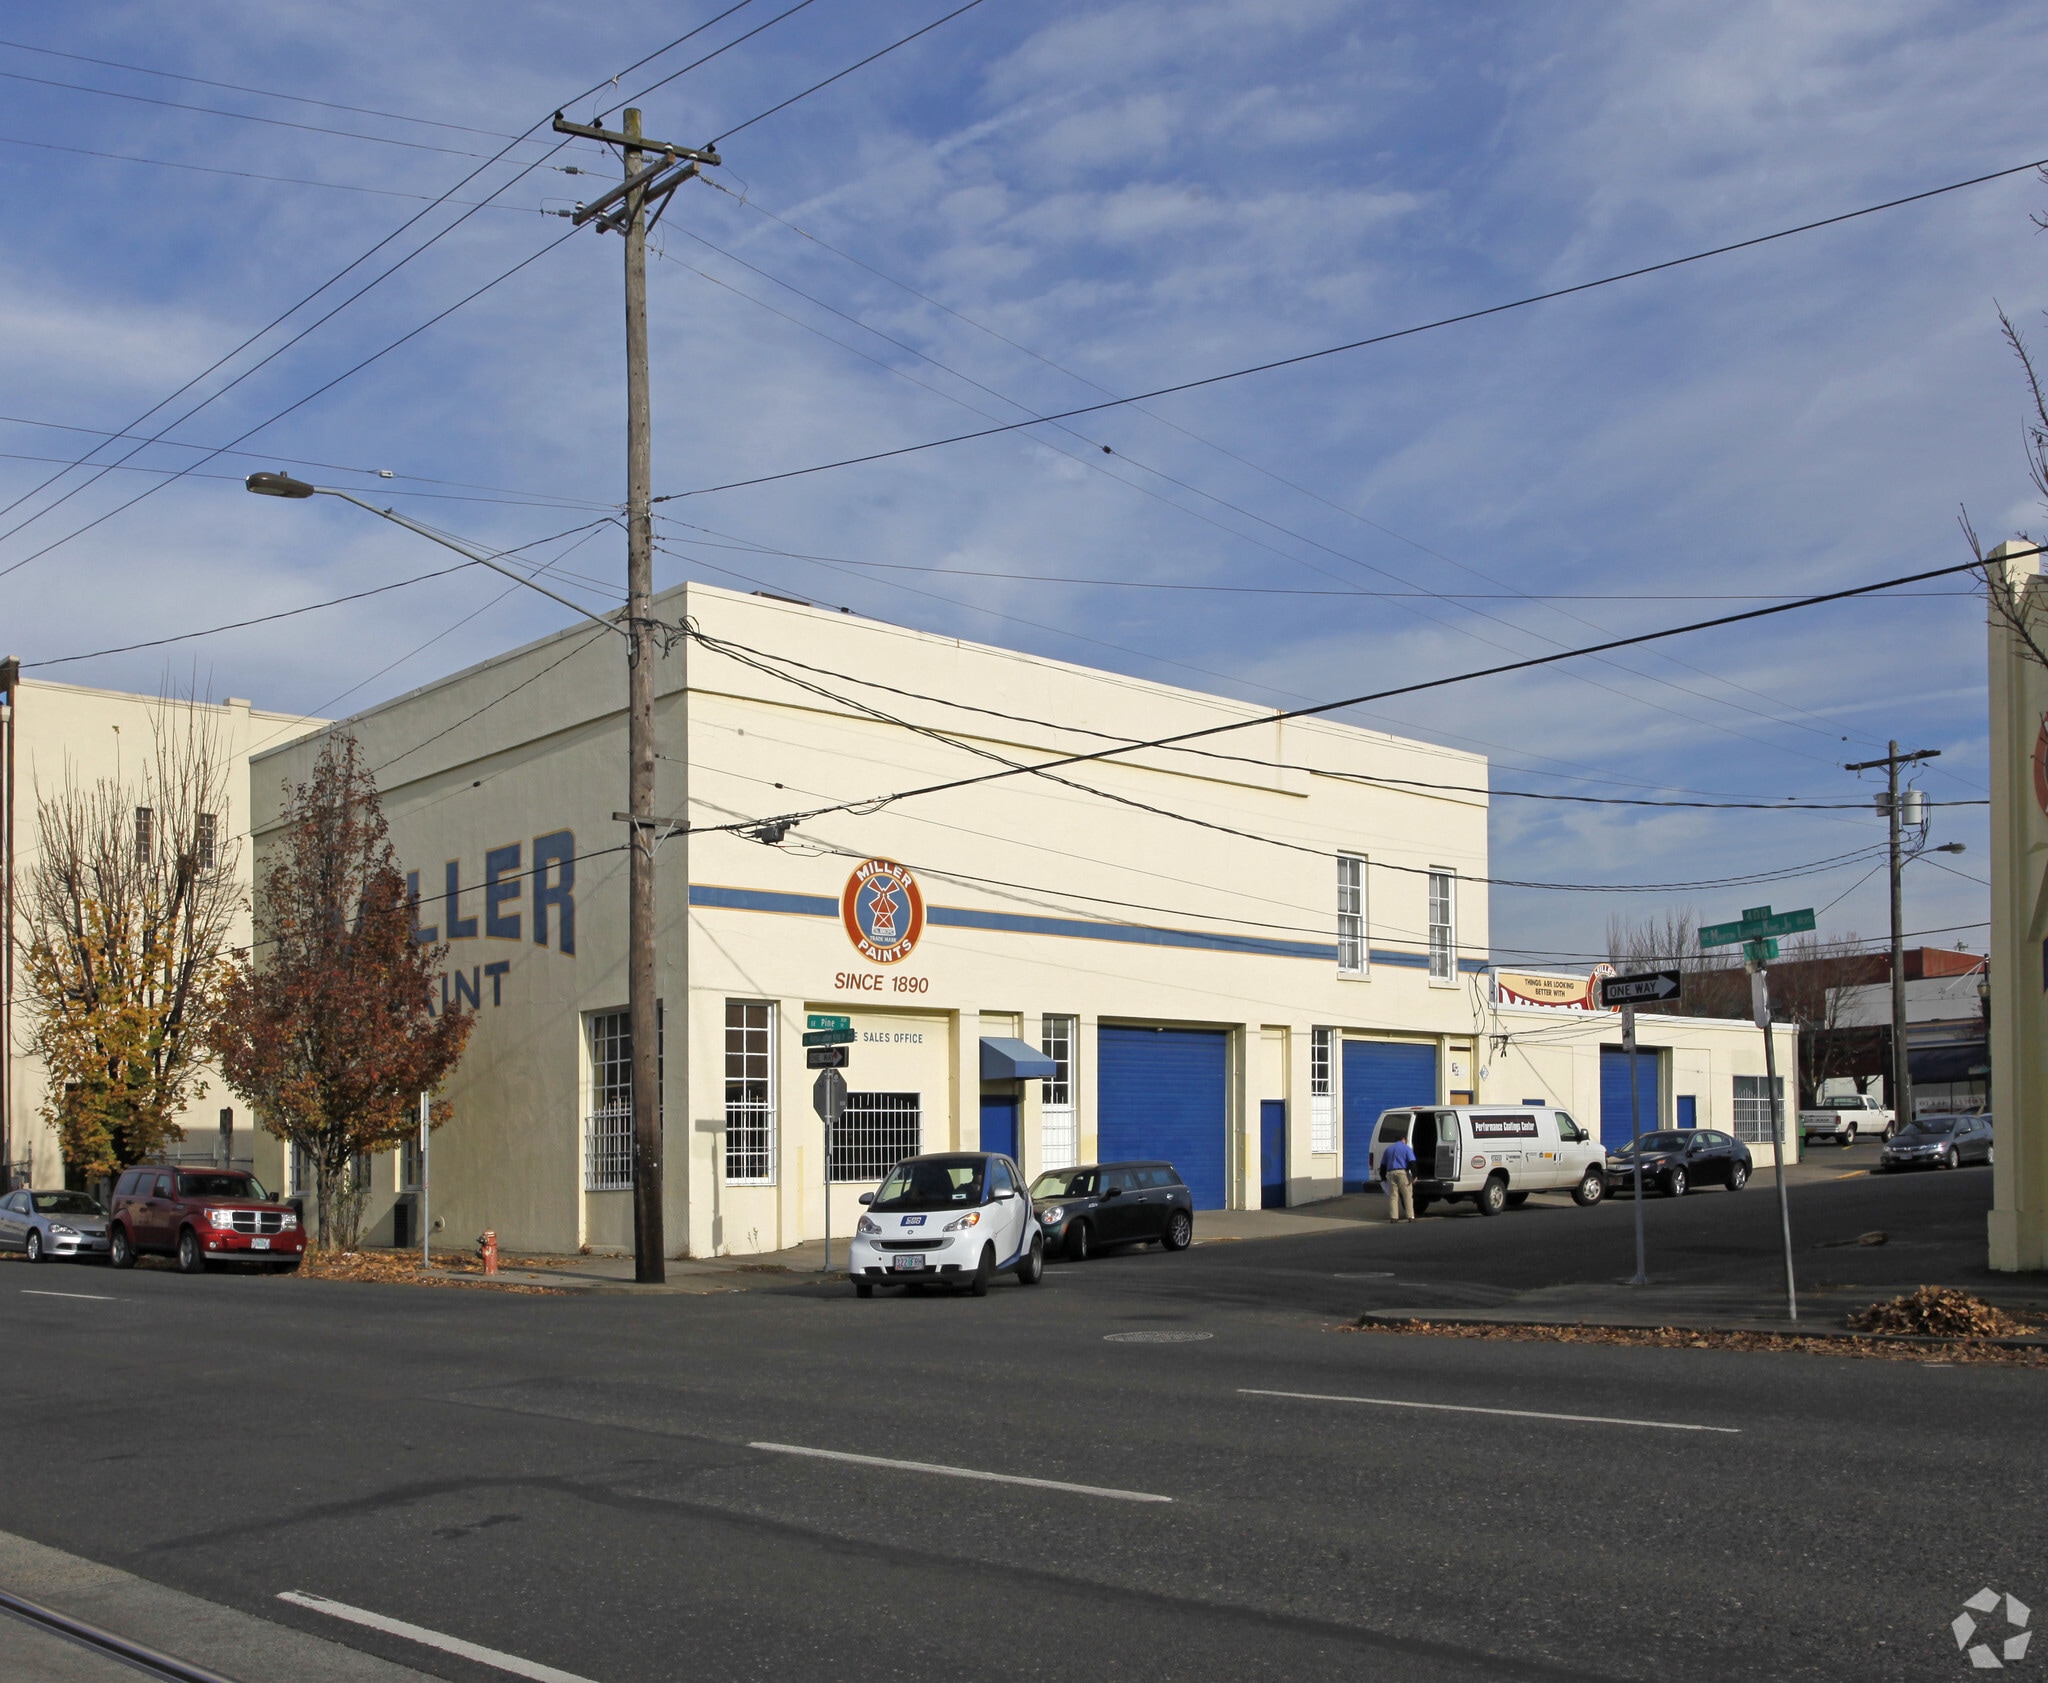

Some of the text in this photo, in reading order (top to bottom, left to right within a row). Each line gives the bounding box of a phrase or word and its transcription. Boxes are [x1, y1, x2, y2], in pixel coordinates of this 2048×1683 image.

[855, 860, 913, 888] MILLER
[857, 938, 913, 962] PAINTS
[1595, 965, 1617, 978] MILLE
[834, 972, 929, 994] SINCE 1890
[1524, 978, 1574, 989] THINGS ARE LOOKING
[1535, 988, 1566, 997] BETTER WITH
[1609, 982, 1656, 998] ONE WAY
[820, 1018, 835, 1028] Pine
[863, 1032, 890, 1043] SALES
[894, 1033, 923, 1043] OFFICE
[1475, 1121, 1535, 1133] Performance Coatings Center
